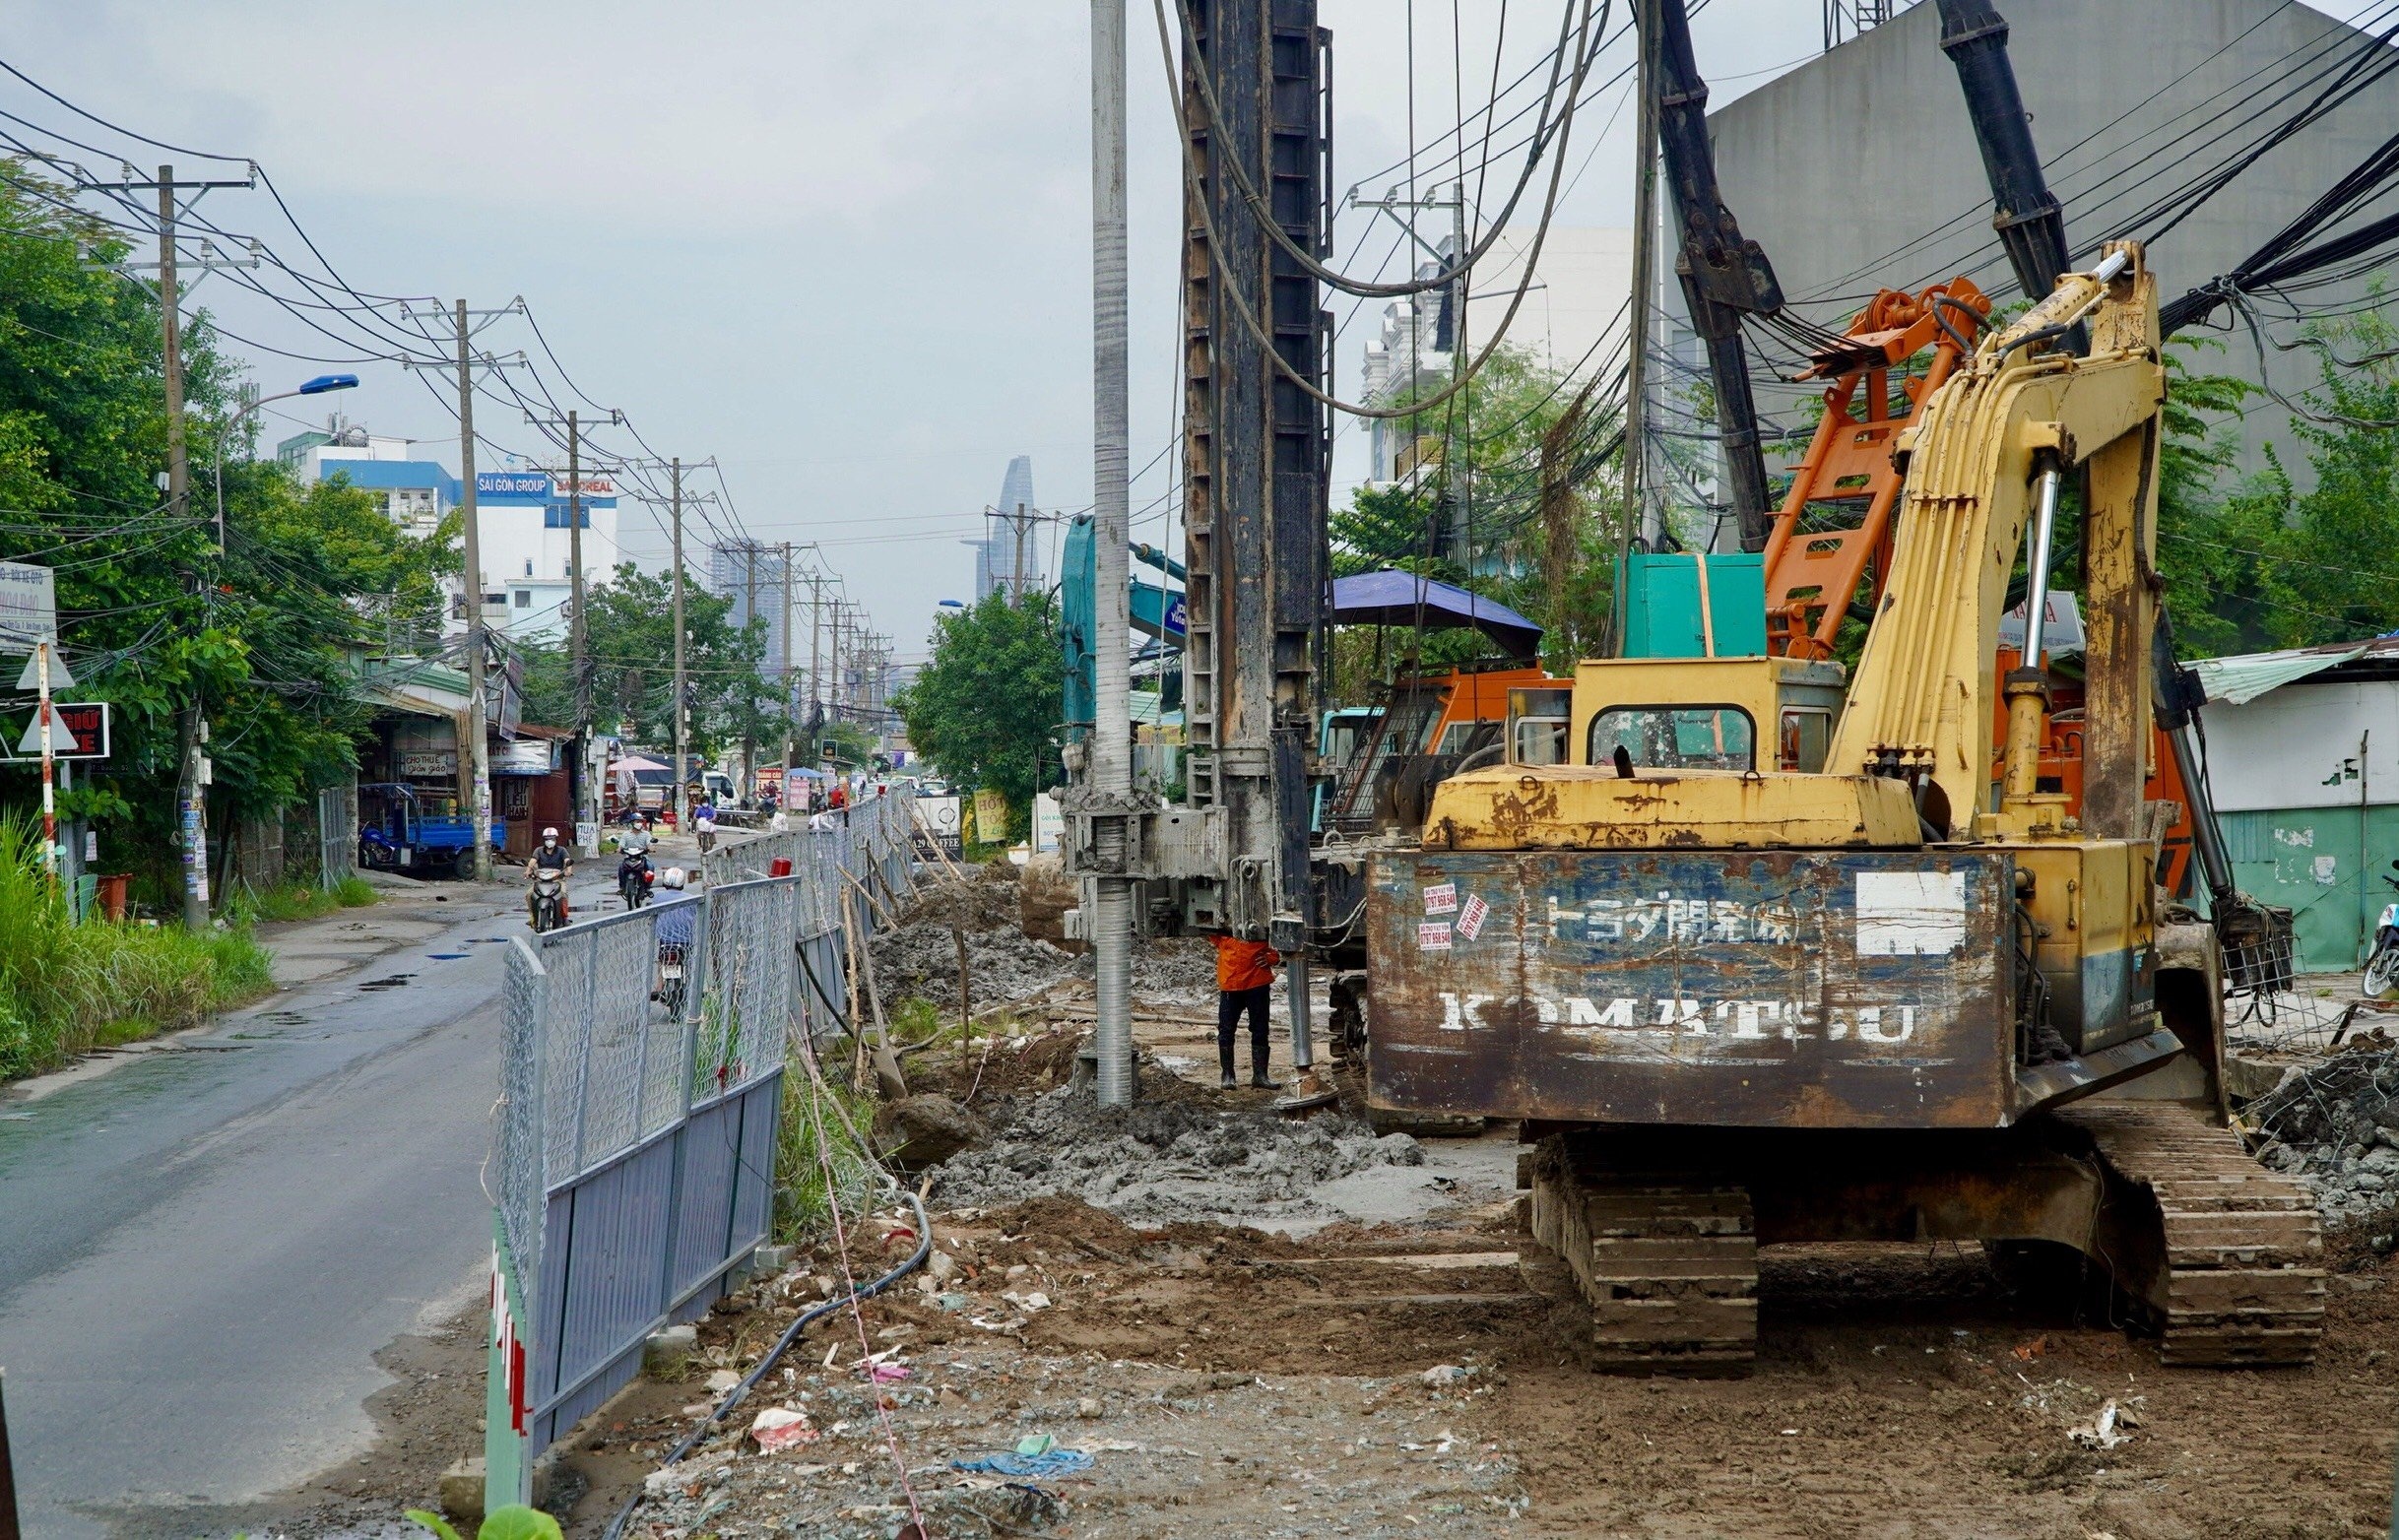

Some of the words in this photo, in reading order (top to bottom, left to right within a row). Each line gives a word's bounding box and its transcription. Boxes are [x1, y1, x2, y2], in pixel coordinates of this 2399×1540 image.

[479, 476, 493, 490] SÀI
[495, 476, 514, 491] GÒN
[516, 480, 546, 491] GROUP
[578, 824, 596, 835] MUA
